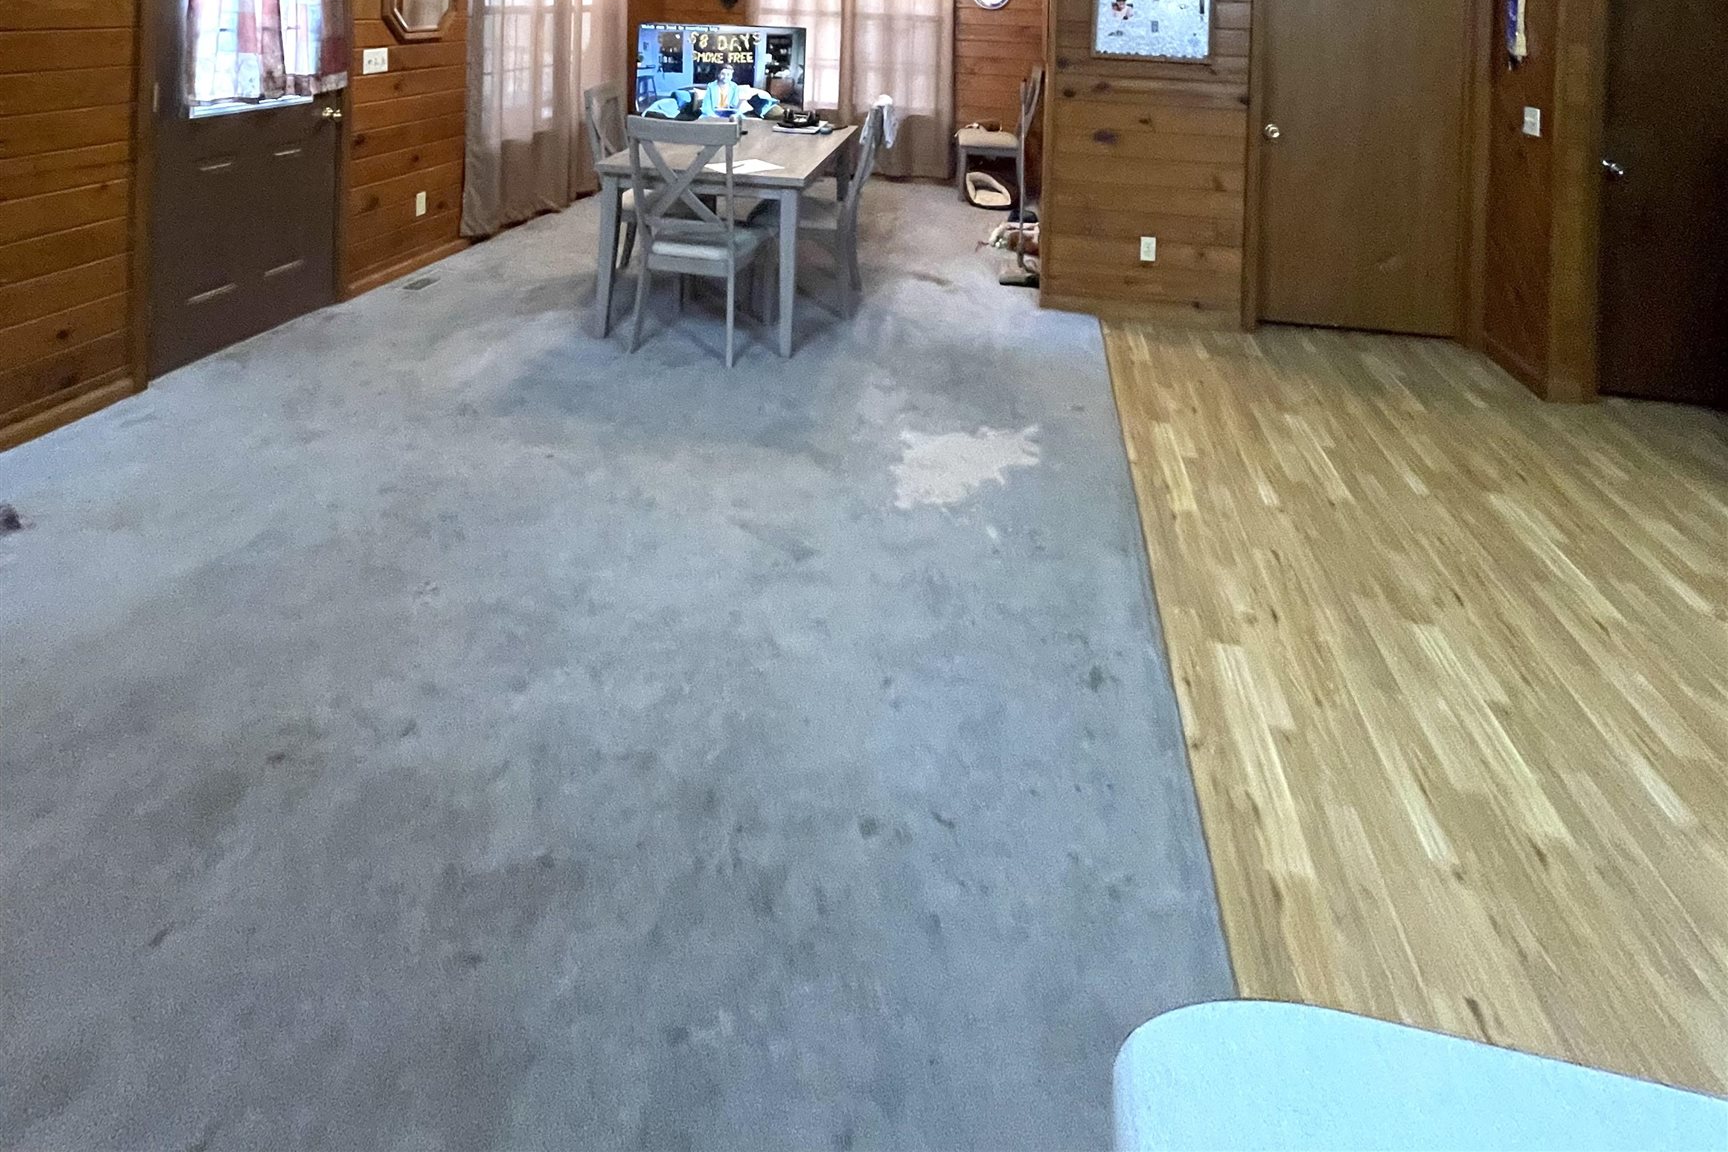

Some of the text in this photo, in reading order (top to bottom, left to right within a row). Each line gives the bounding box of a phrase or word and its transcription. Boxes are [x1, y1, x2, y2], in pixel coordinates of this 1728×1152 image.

[717, 32, 761, 51] DAYS
[692, 51, 754, 64] SMOKE FREE
